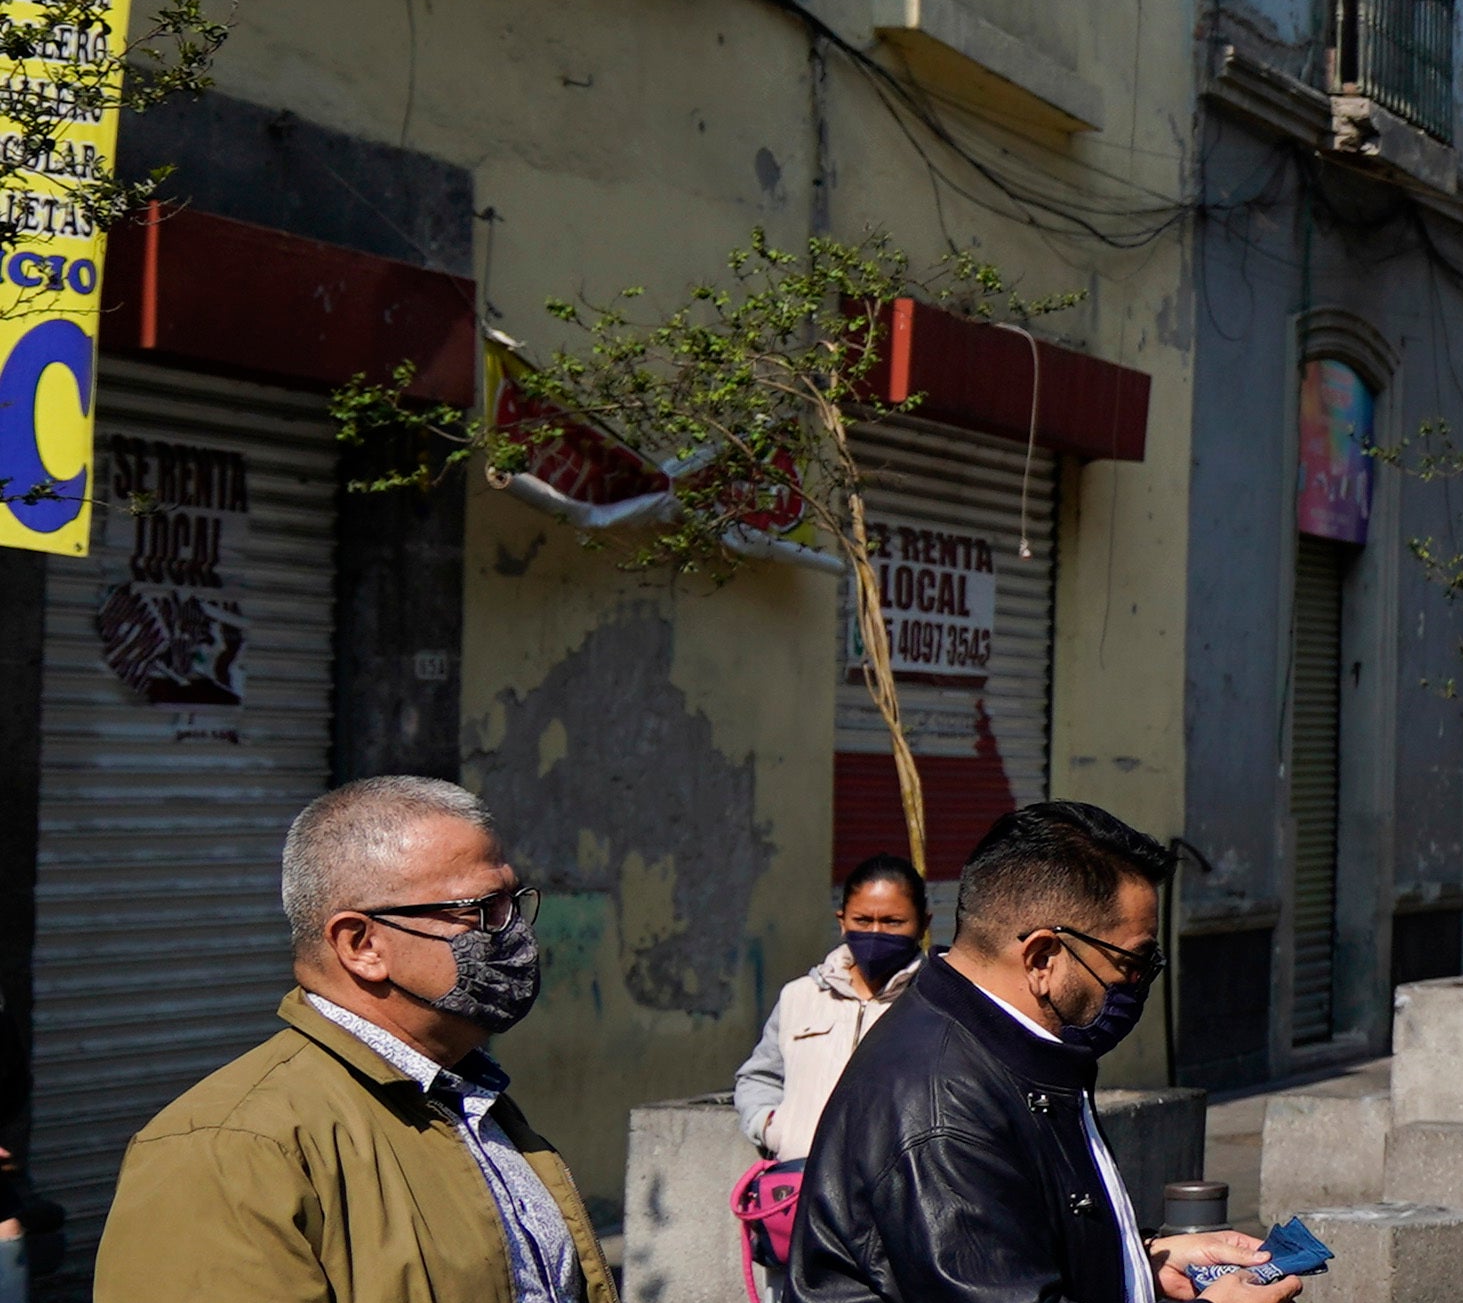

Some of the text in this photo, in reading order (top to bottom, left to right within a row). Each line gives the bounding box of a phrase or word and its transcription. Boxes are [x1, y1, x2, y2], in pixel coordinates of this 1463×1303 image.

[155, 441, 248, 512] RENTA
[131, 514, 222, 588] LOCAL
[899, 526, 994, 573] RENTA
[879, 564, 970, 618] LOCAL
[898, 619, 943, 664] 4097
[946, 624, 991, 667] 3543
